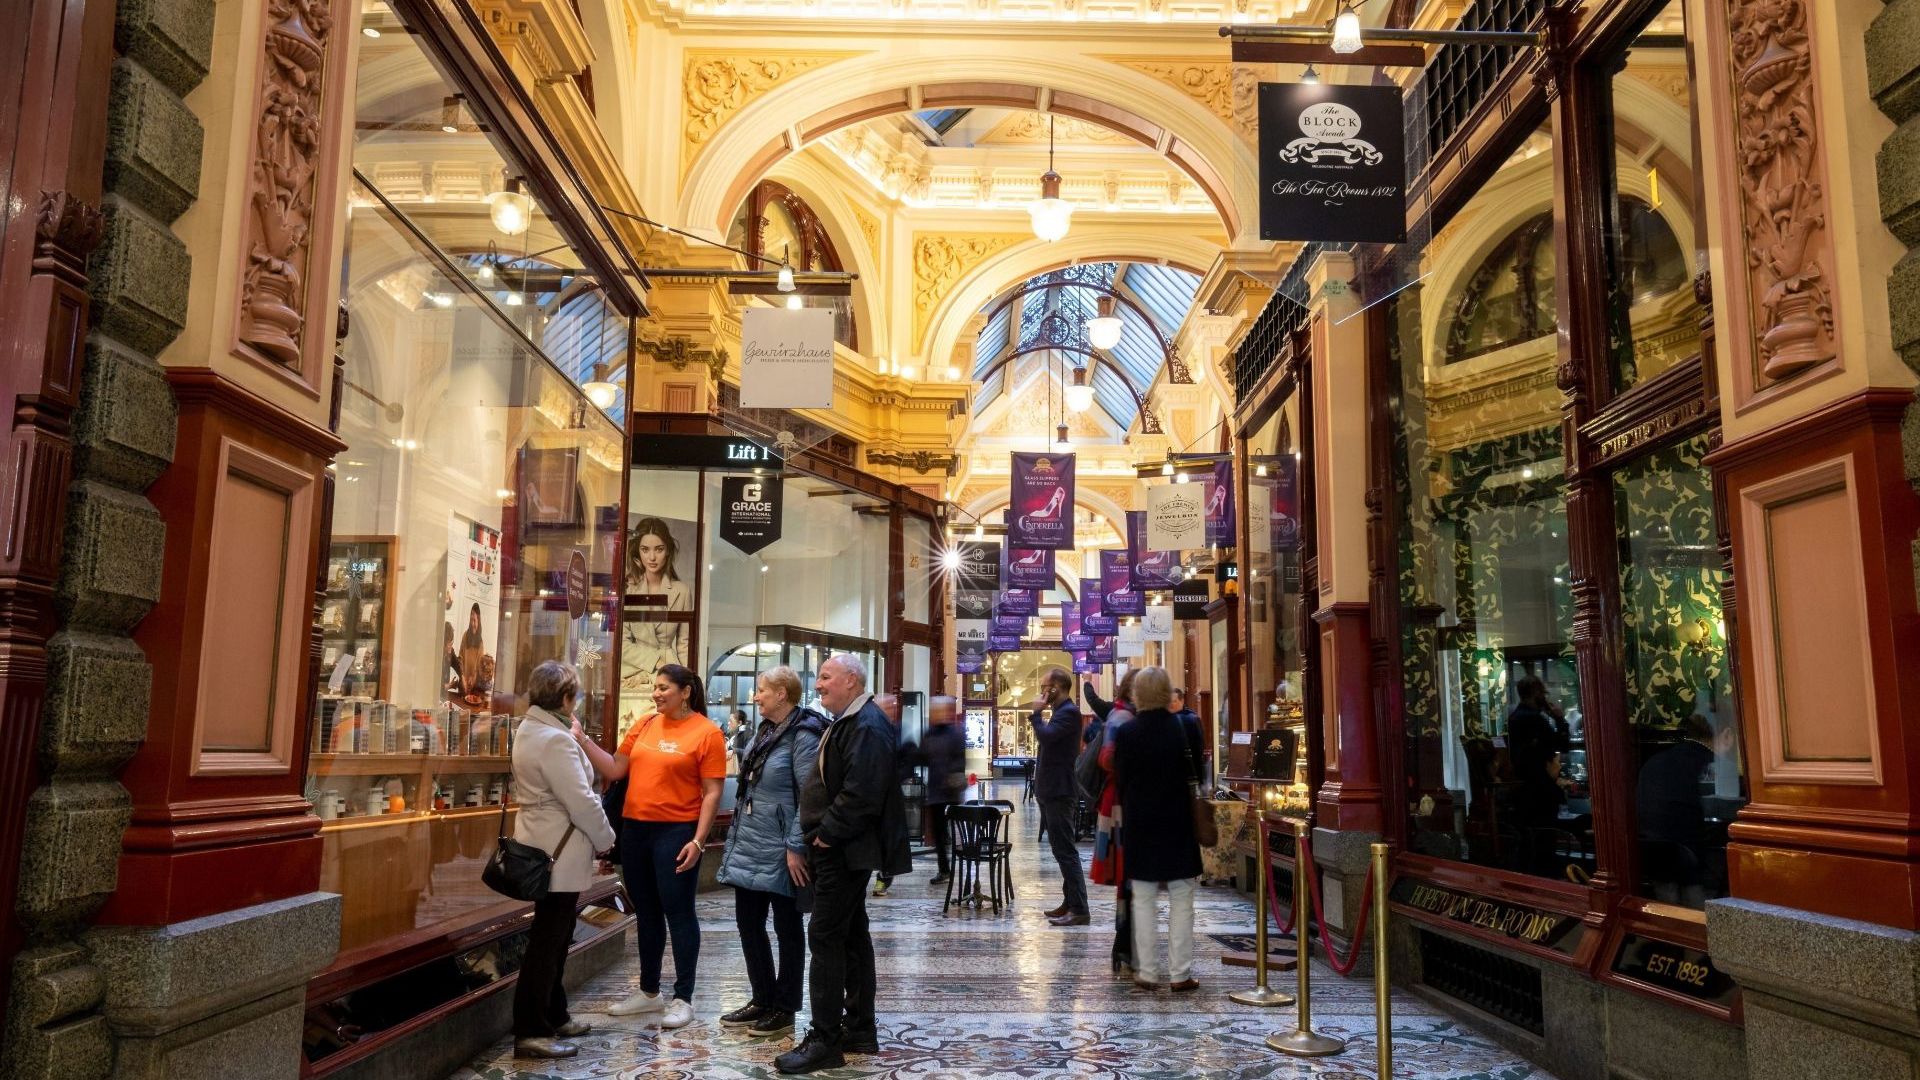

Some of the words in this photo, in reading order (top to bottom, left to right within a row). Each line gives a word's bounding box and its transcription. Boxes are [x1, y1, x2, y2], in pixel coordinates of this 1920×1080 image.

[1320, 106, 1340, 114] The
[1304, 116, 1357, 127] BLOCK
[1315, 129, 1346, 137] Arcade
[1272, 179, 1298, 195] The
[1300, 179, 1329, 196] Tea
[1326, 181, 1369, 198] Rooms
[1371, 186, 1397, 197] 1892
[1647, 167, 1662, 213] 1
[728, 444, 757, 460] Lift
[761, 446, 769, 460] 1
[731, 501, 772, 511] GRACE
[1018, 515, 1064, 533] CINDERELLA
[1010, 561, 1047, 577] CINDERELLA
[1409, 885, 1473, 918] HOPETOUN
[1471, 901, 1500, 928] TEA
[1498, 908, 1556, 942] ROOMS
[1647, 953, 1675, 976] EST.
[1675, 960, 1709, 986] 1892
